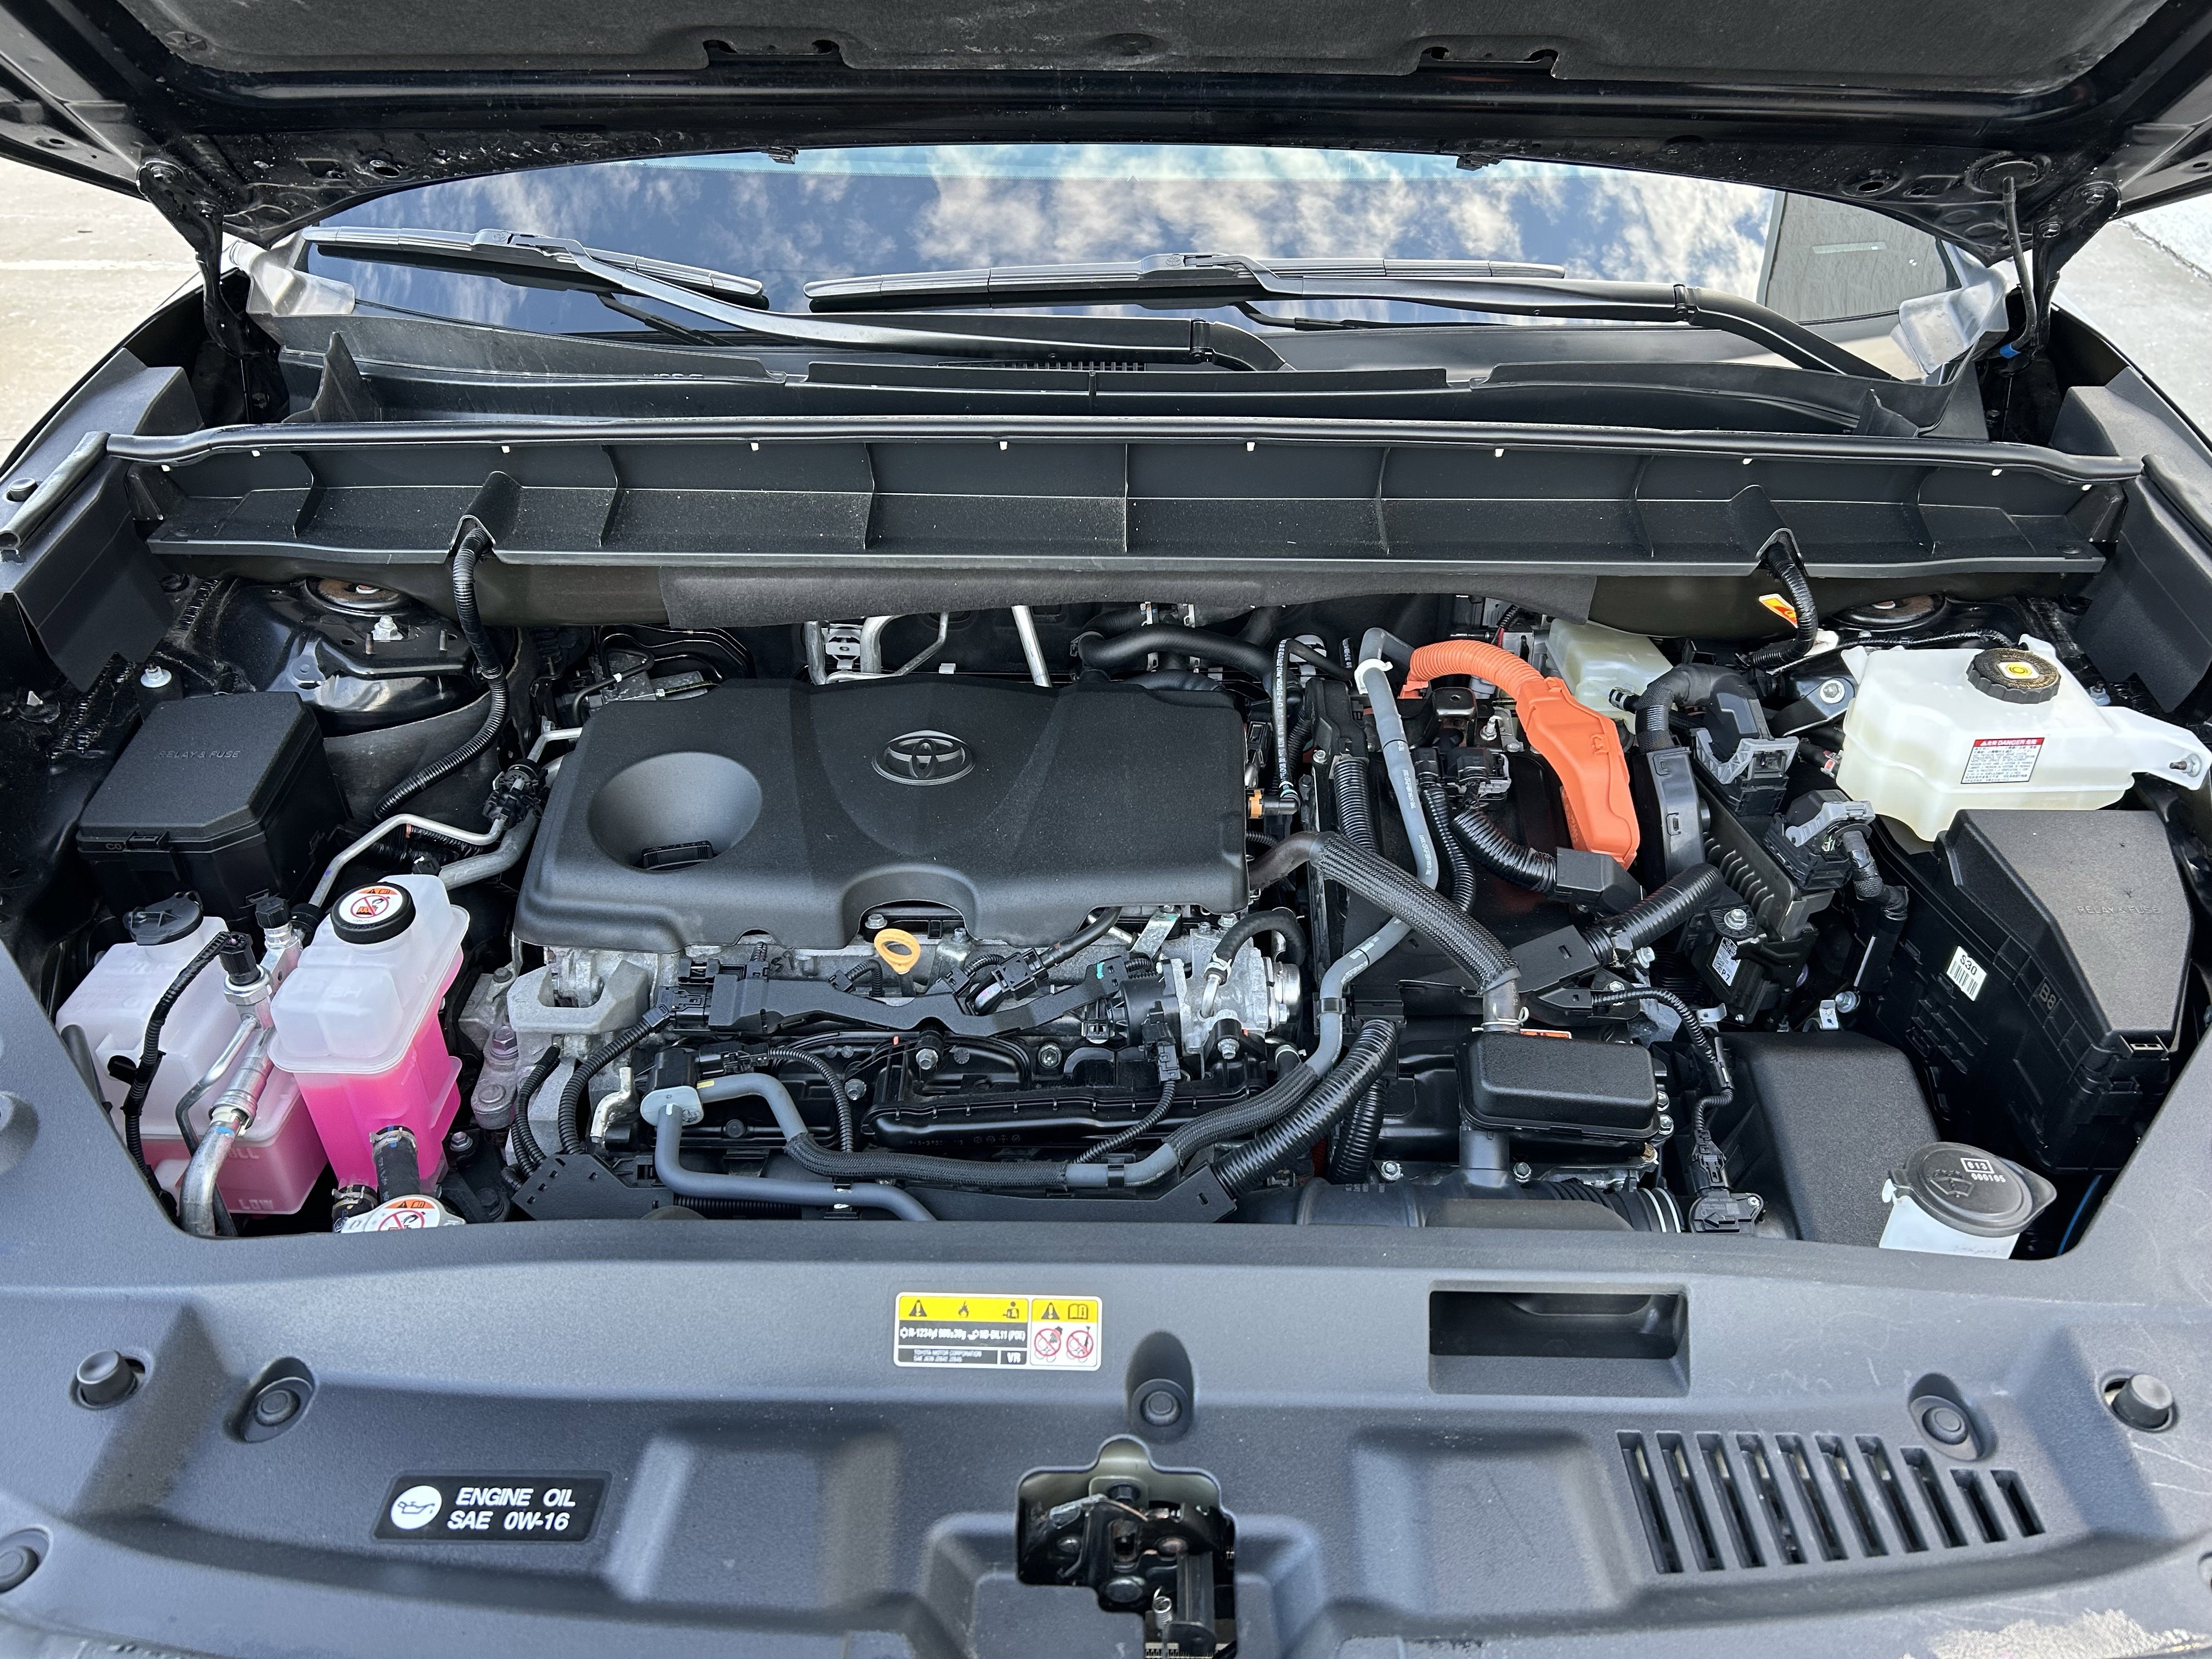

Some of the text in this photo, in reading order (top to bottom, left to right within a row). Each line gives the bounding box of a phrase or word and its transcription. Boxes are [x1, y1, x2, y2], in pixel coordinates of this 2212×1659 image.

[209, 750, 241, 758] FUSE
[2128, 905, 2160, 914] FUSE
[1960, 954, 1978, 975] S30
[2039, 982, 2057, 1011] B8
[227, 1147, 259, 1159] ULL
[1971, 1173, 2006, 1183] 000105
[238, 1199, 274, 1210] LOW
[455, 1487, 576, 1507] ENGINE OIL
[447, 1510, 571, 1531] SAE 0W-16
